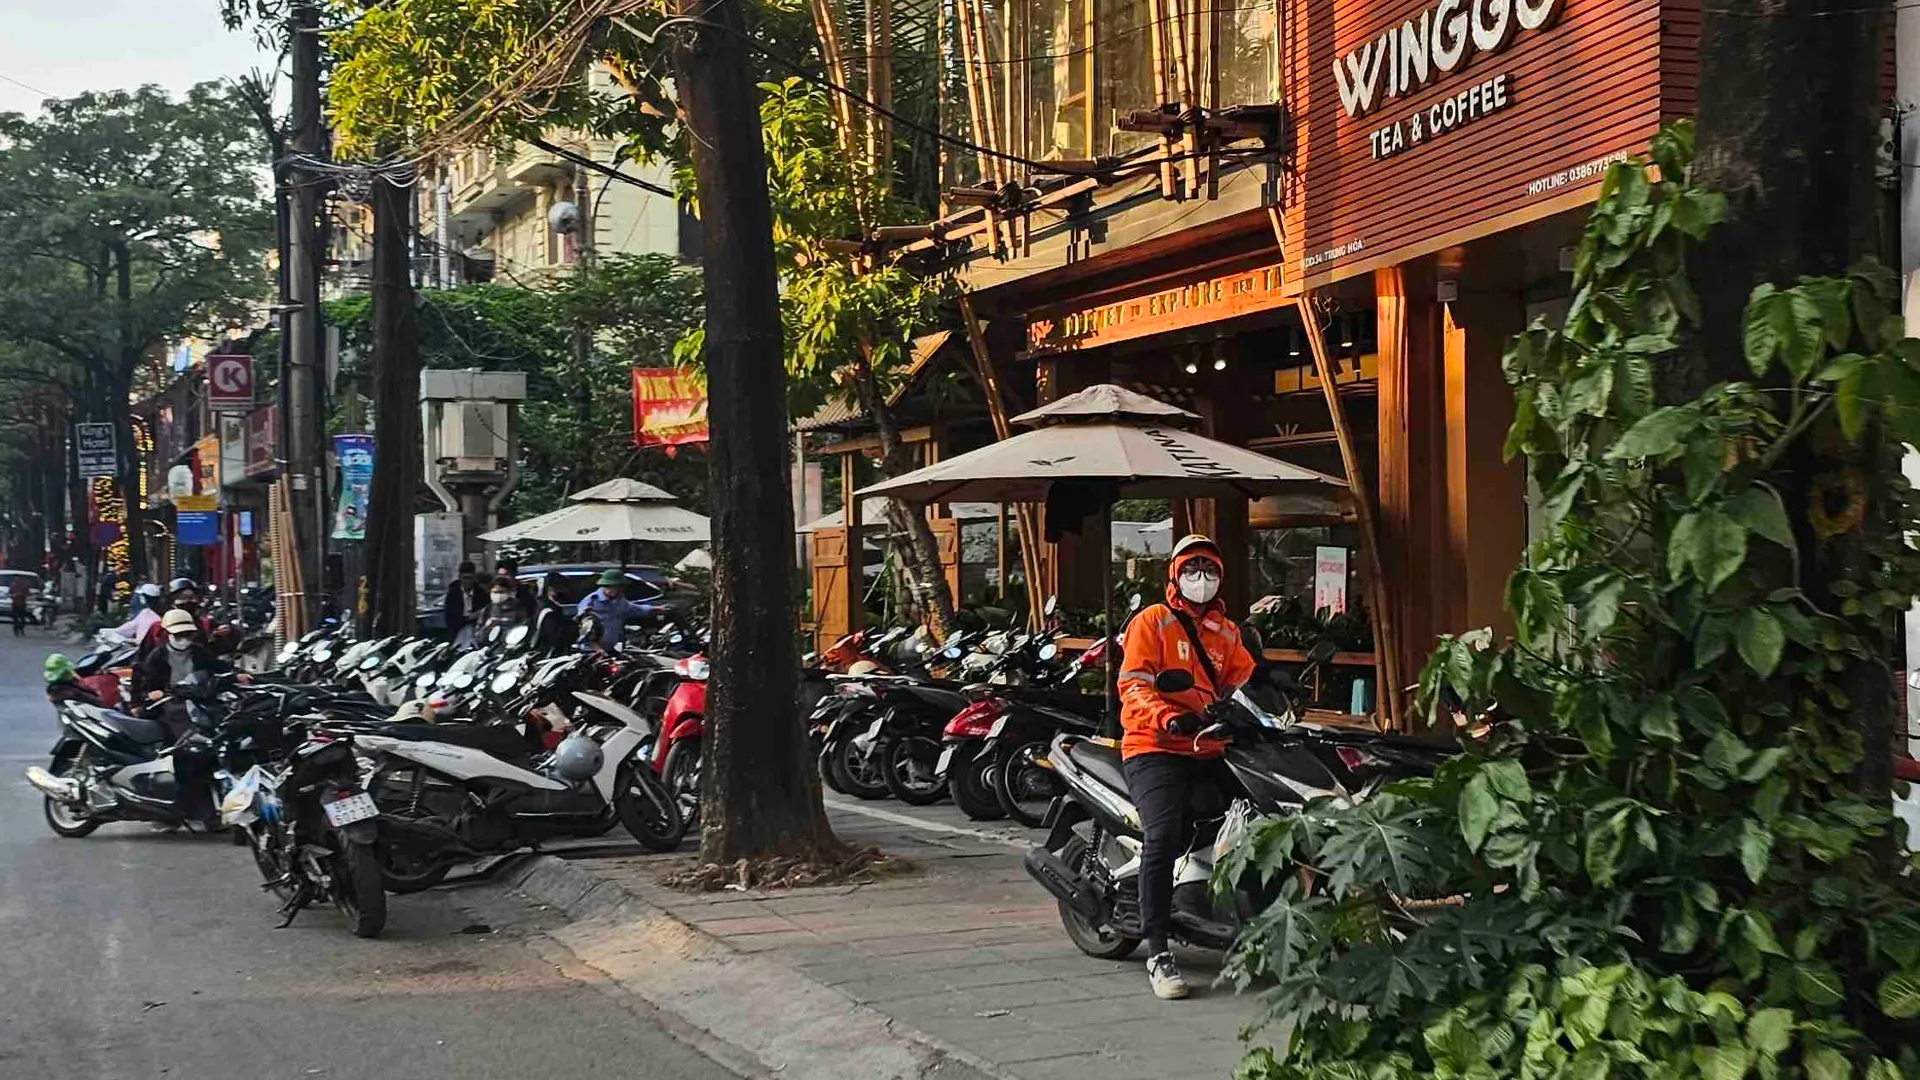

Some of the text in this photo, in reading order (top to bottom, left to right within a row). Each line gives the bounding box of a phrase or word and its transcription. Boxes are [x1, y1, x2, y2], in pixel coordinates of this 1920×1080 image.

[1369, 74, 1508, 160] TEA & COFFEE
[1528, 172, 1568, 196] HOTLINE:
[1149, 280, 1225, 316] EXPLORE
[222, 366, 249, 391] K
